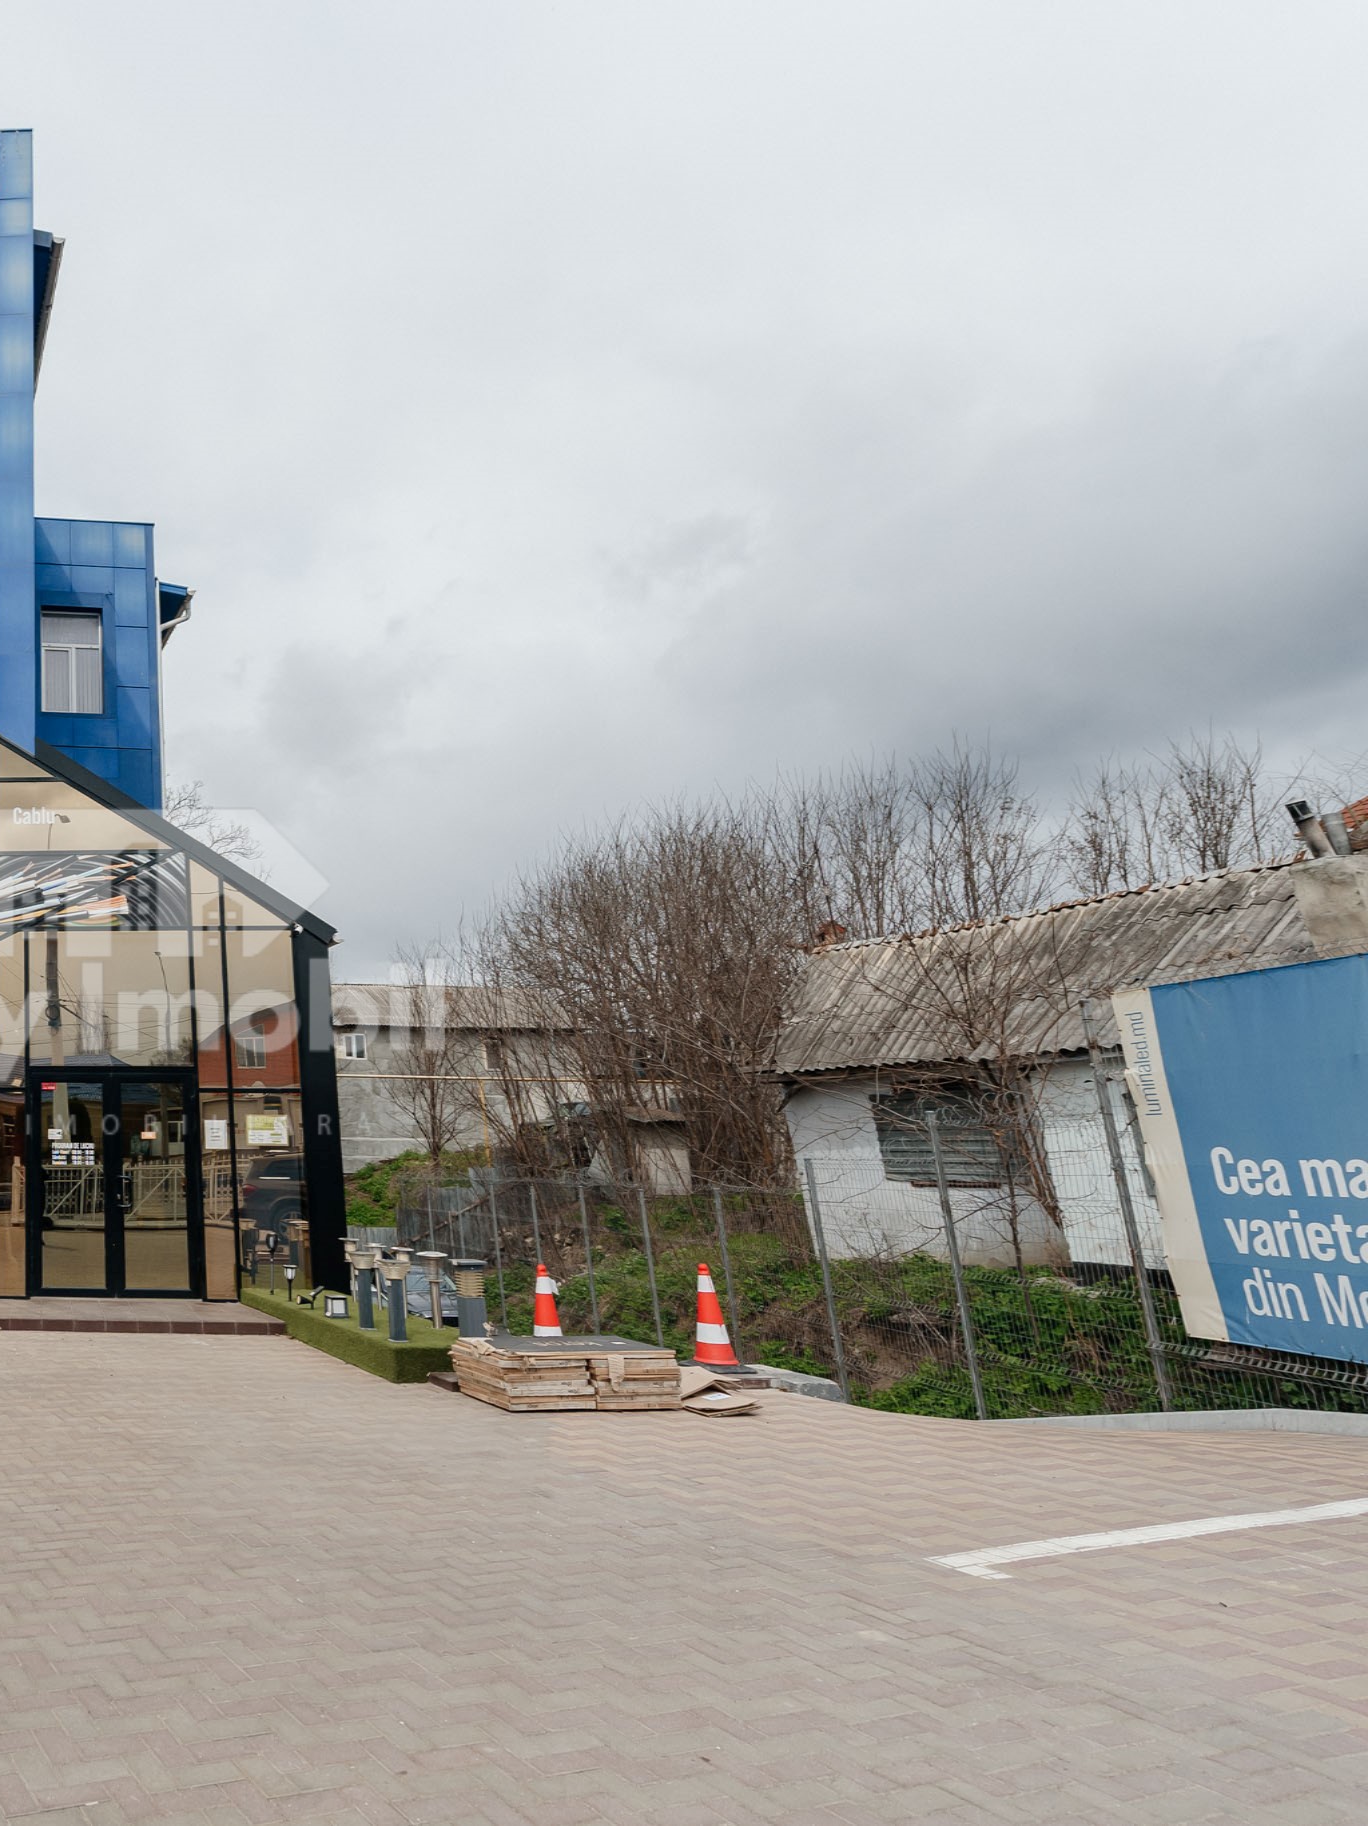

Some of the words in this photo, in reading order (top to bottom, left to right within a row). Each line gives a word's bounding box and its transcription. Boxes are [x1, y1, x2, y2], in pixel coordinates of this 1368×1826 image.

[12, 806, 55, 825] Cablu
[1124, 1011, 1163, 1116] luminaled.md
[1210, 1146, 1292, 1196] Cea
[1242, 1266, 1310, 1322] din
